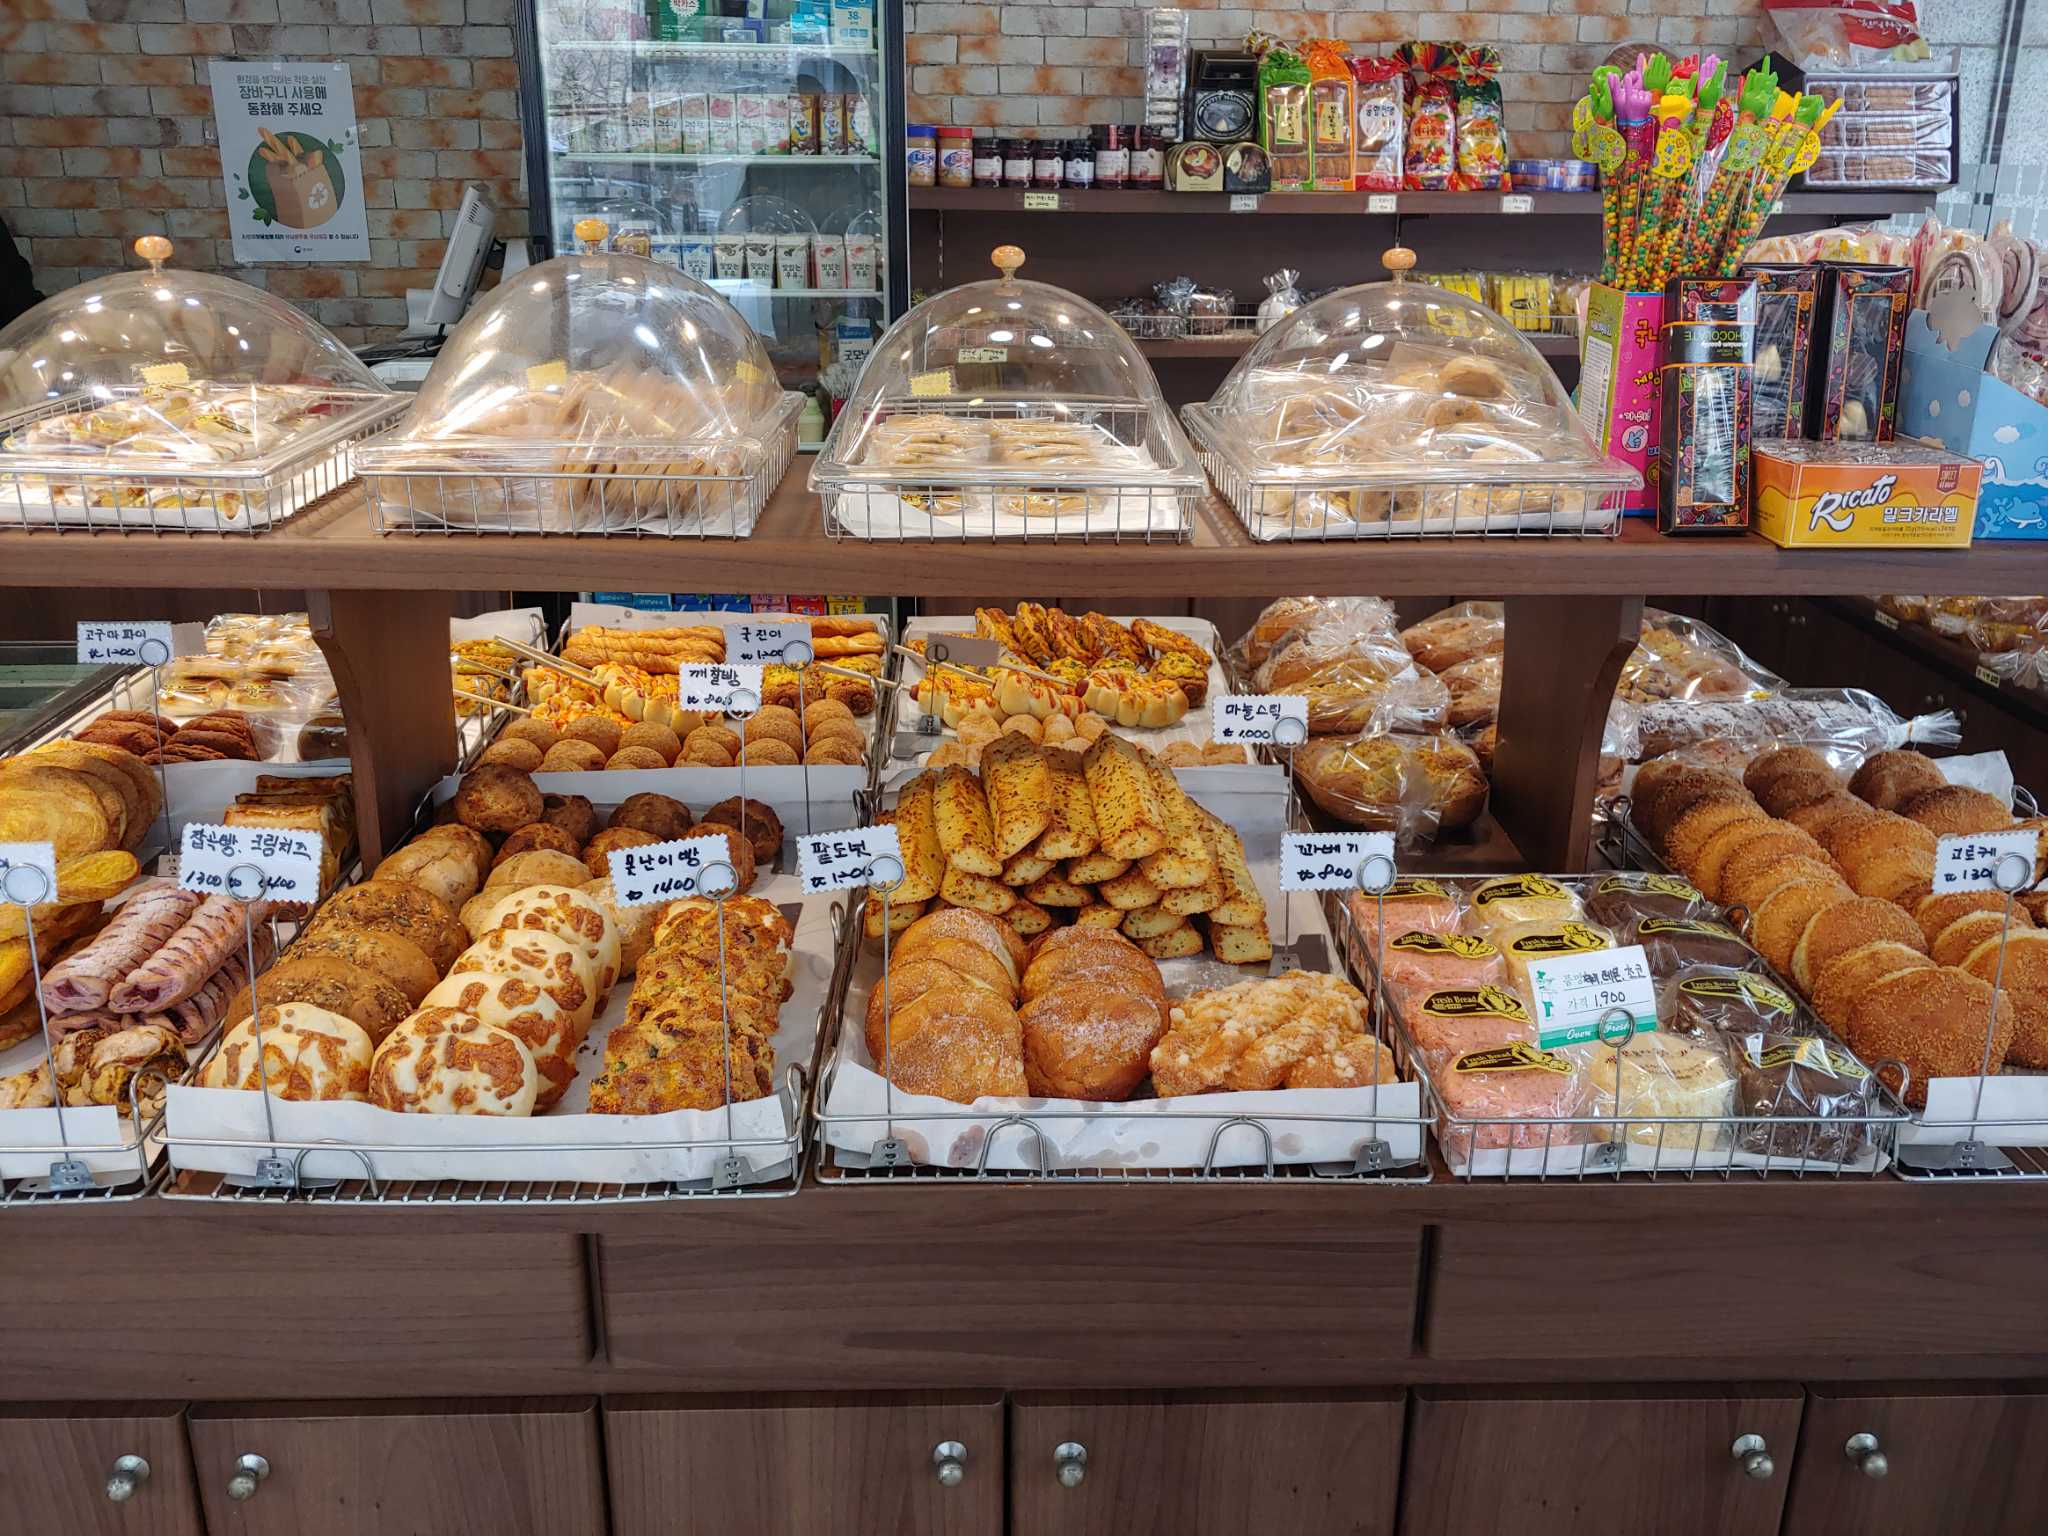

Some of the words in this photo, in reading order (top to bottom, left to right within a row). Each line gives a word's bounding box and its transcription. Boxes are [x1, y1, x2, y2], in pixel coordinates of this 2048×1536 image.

[239, 85, 288, 100] 장바구니
[291, 85, 327, 100] 사용에
[247, 101, 284, 116] 동참해
[287, 101, 324, 116] 주세요
[1809, 474, 1897, 532] Ricato
[1882, 507, 1958, 524] 밀크카라멜
[1432, 996, 1453, 1005] Fresh
